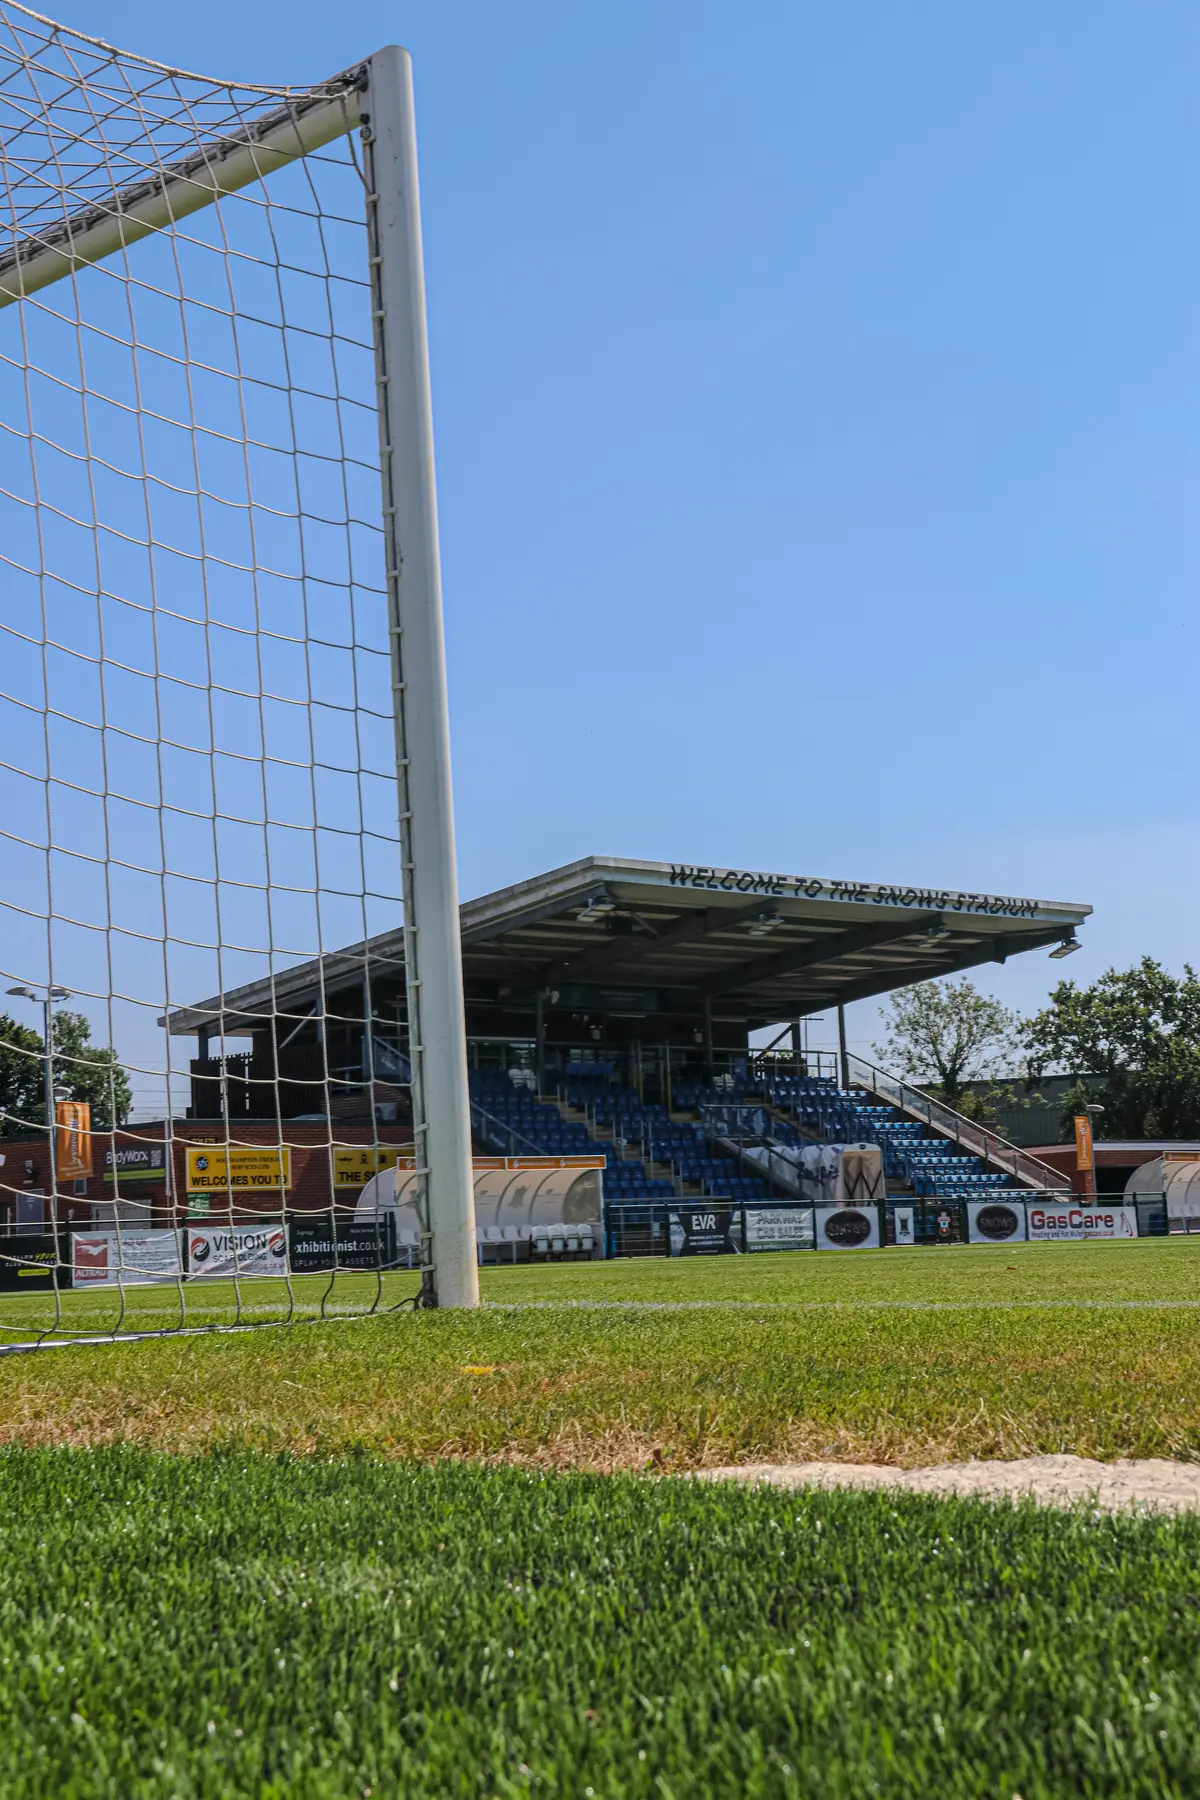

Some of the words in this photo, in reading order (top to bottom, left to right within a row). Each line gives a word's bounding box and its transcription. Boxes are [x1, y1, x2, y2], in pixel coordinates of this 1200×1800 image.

[669, 865, 787, 895] WELCOME
[794, 878, 823, 898] TO
[829, 881, 870, 902] THE
[872, 886, 950, 910] SNOWS
[952, 893, 1038, 918] STADIUM
[106, 1150, 148, 1165] BdyWorx
[250, 1174, 272, 1185] YOU
[338, 1171, 361, 1182] THE
[691, 1214, 716, 1230] EVR
[980, 1217, 1014, 1229] SNOWS
[1031, 1210, 1114, 1229] GasCare
[213, 1234, 267, 1251] VISION
[213, 1252, 267, 1263] SCAFOLDING
[345, 1256, 375, 1265] ASSETS
[75, 1269, 106, 1278] ALTRAD
